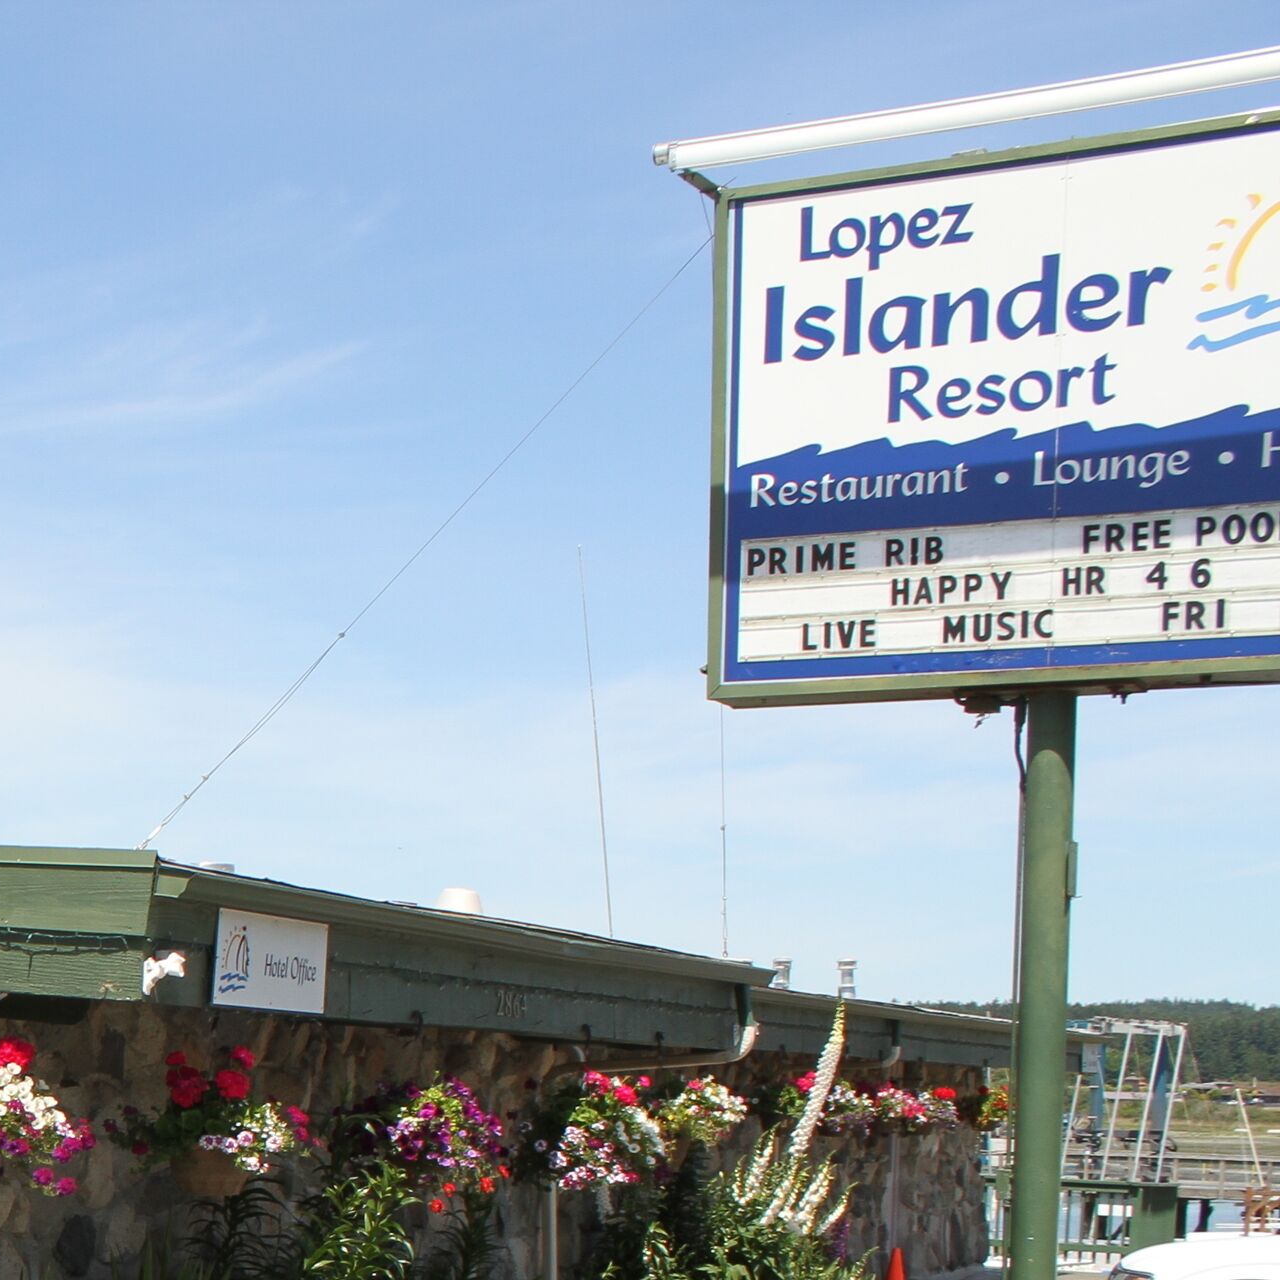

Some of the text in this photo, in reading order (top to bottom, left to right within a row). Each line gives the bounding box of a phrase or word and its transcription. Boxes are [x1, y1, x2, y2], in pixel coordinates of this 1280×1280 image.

[799, 203, 974, 271] Lopez
[763, 254, 1173, 364] Islander
[887, 354, 1118, 424] Resort
[749, 461, 969, 508] Restaurant
[1033, 449, 1190, 489] Lounge
[747, 511, 1280, 576] PRIME RIB FREE POO
[890, 558, 1212, 607] HAPPY HR 4 6
[802, 599, 1226, 651] LIVE MUSIC FRI
[264, 952, 317, 986] Hotel Office
